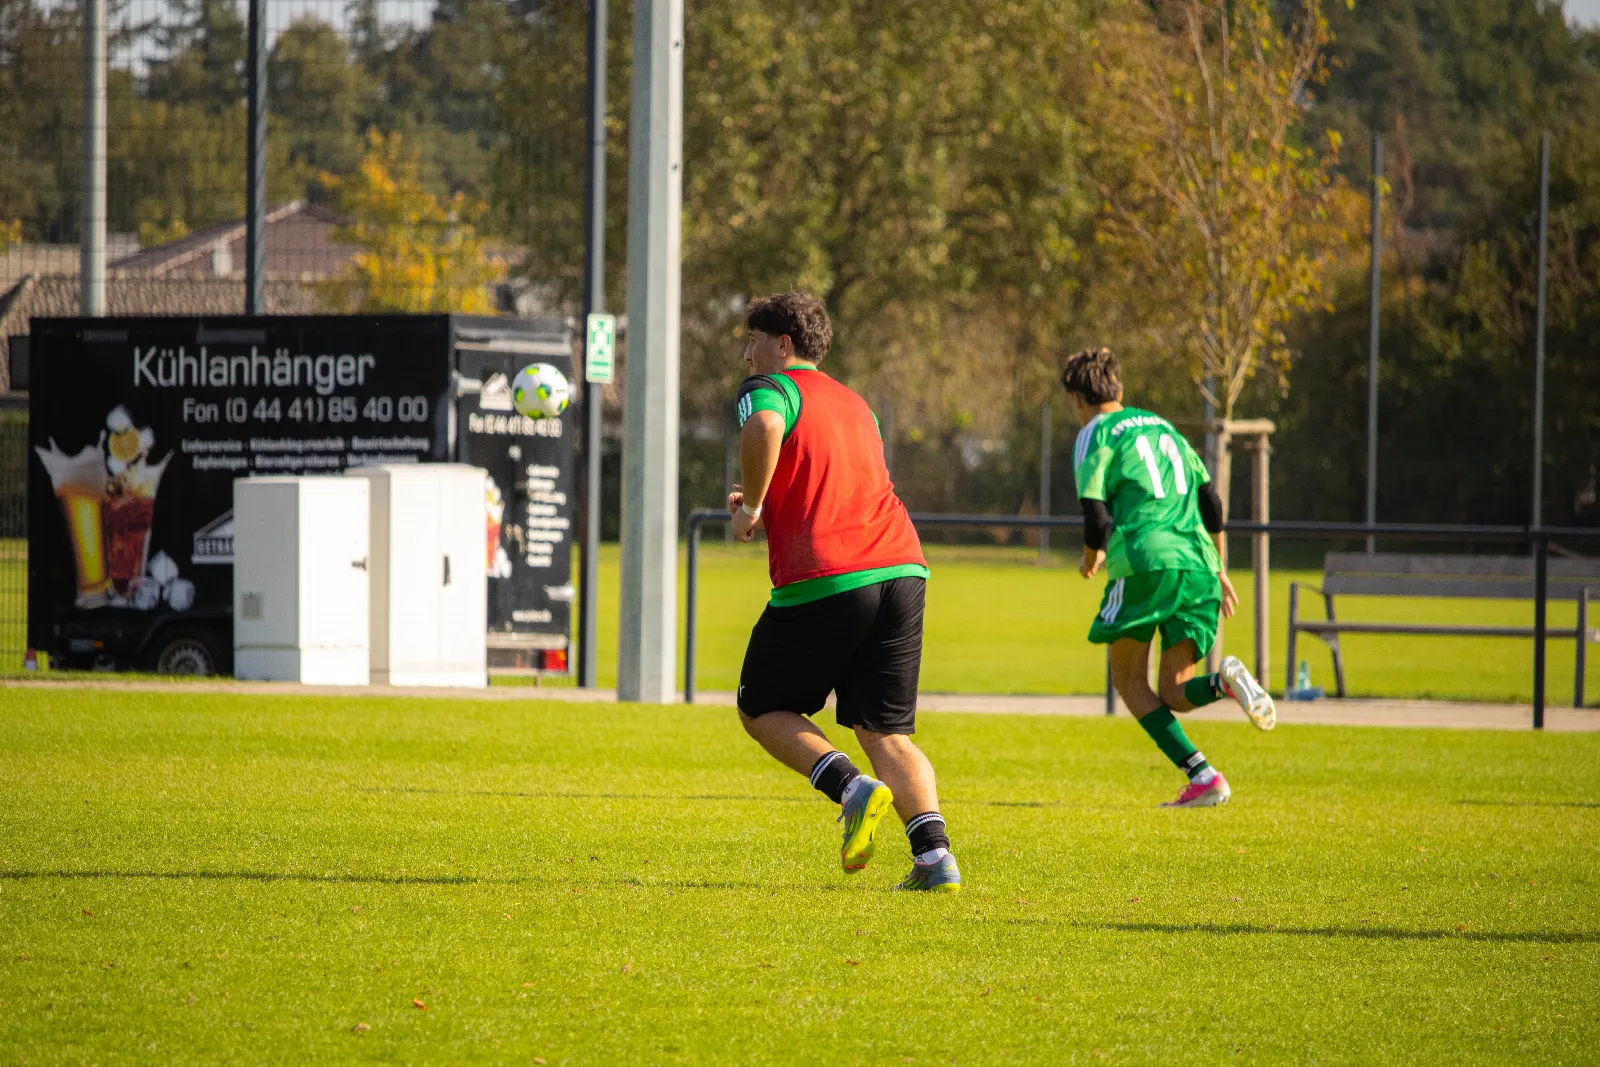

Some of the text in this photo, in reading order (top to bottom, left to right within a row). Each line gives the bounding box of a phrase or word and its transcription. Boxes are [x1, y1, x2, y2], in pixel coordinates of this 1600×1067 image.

[133, 346, 376, 395] Kühlanhänger
[183, 398, 218, 423] Fon
[252, 398, 281, 423] 44
[287, 396, 325, 423] 41)
[328, 396, 358, 423] 85
[363, 396, 393, 423] 40
[398, 396, 429, 422] 00
[1136, 434, 1187, 498] 11
